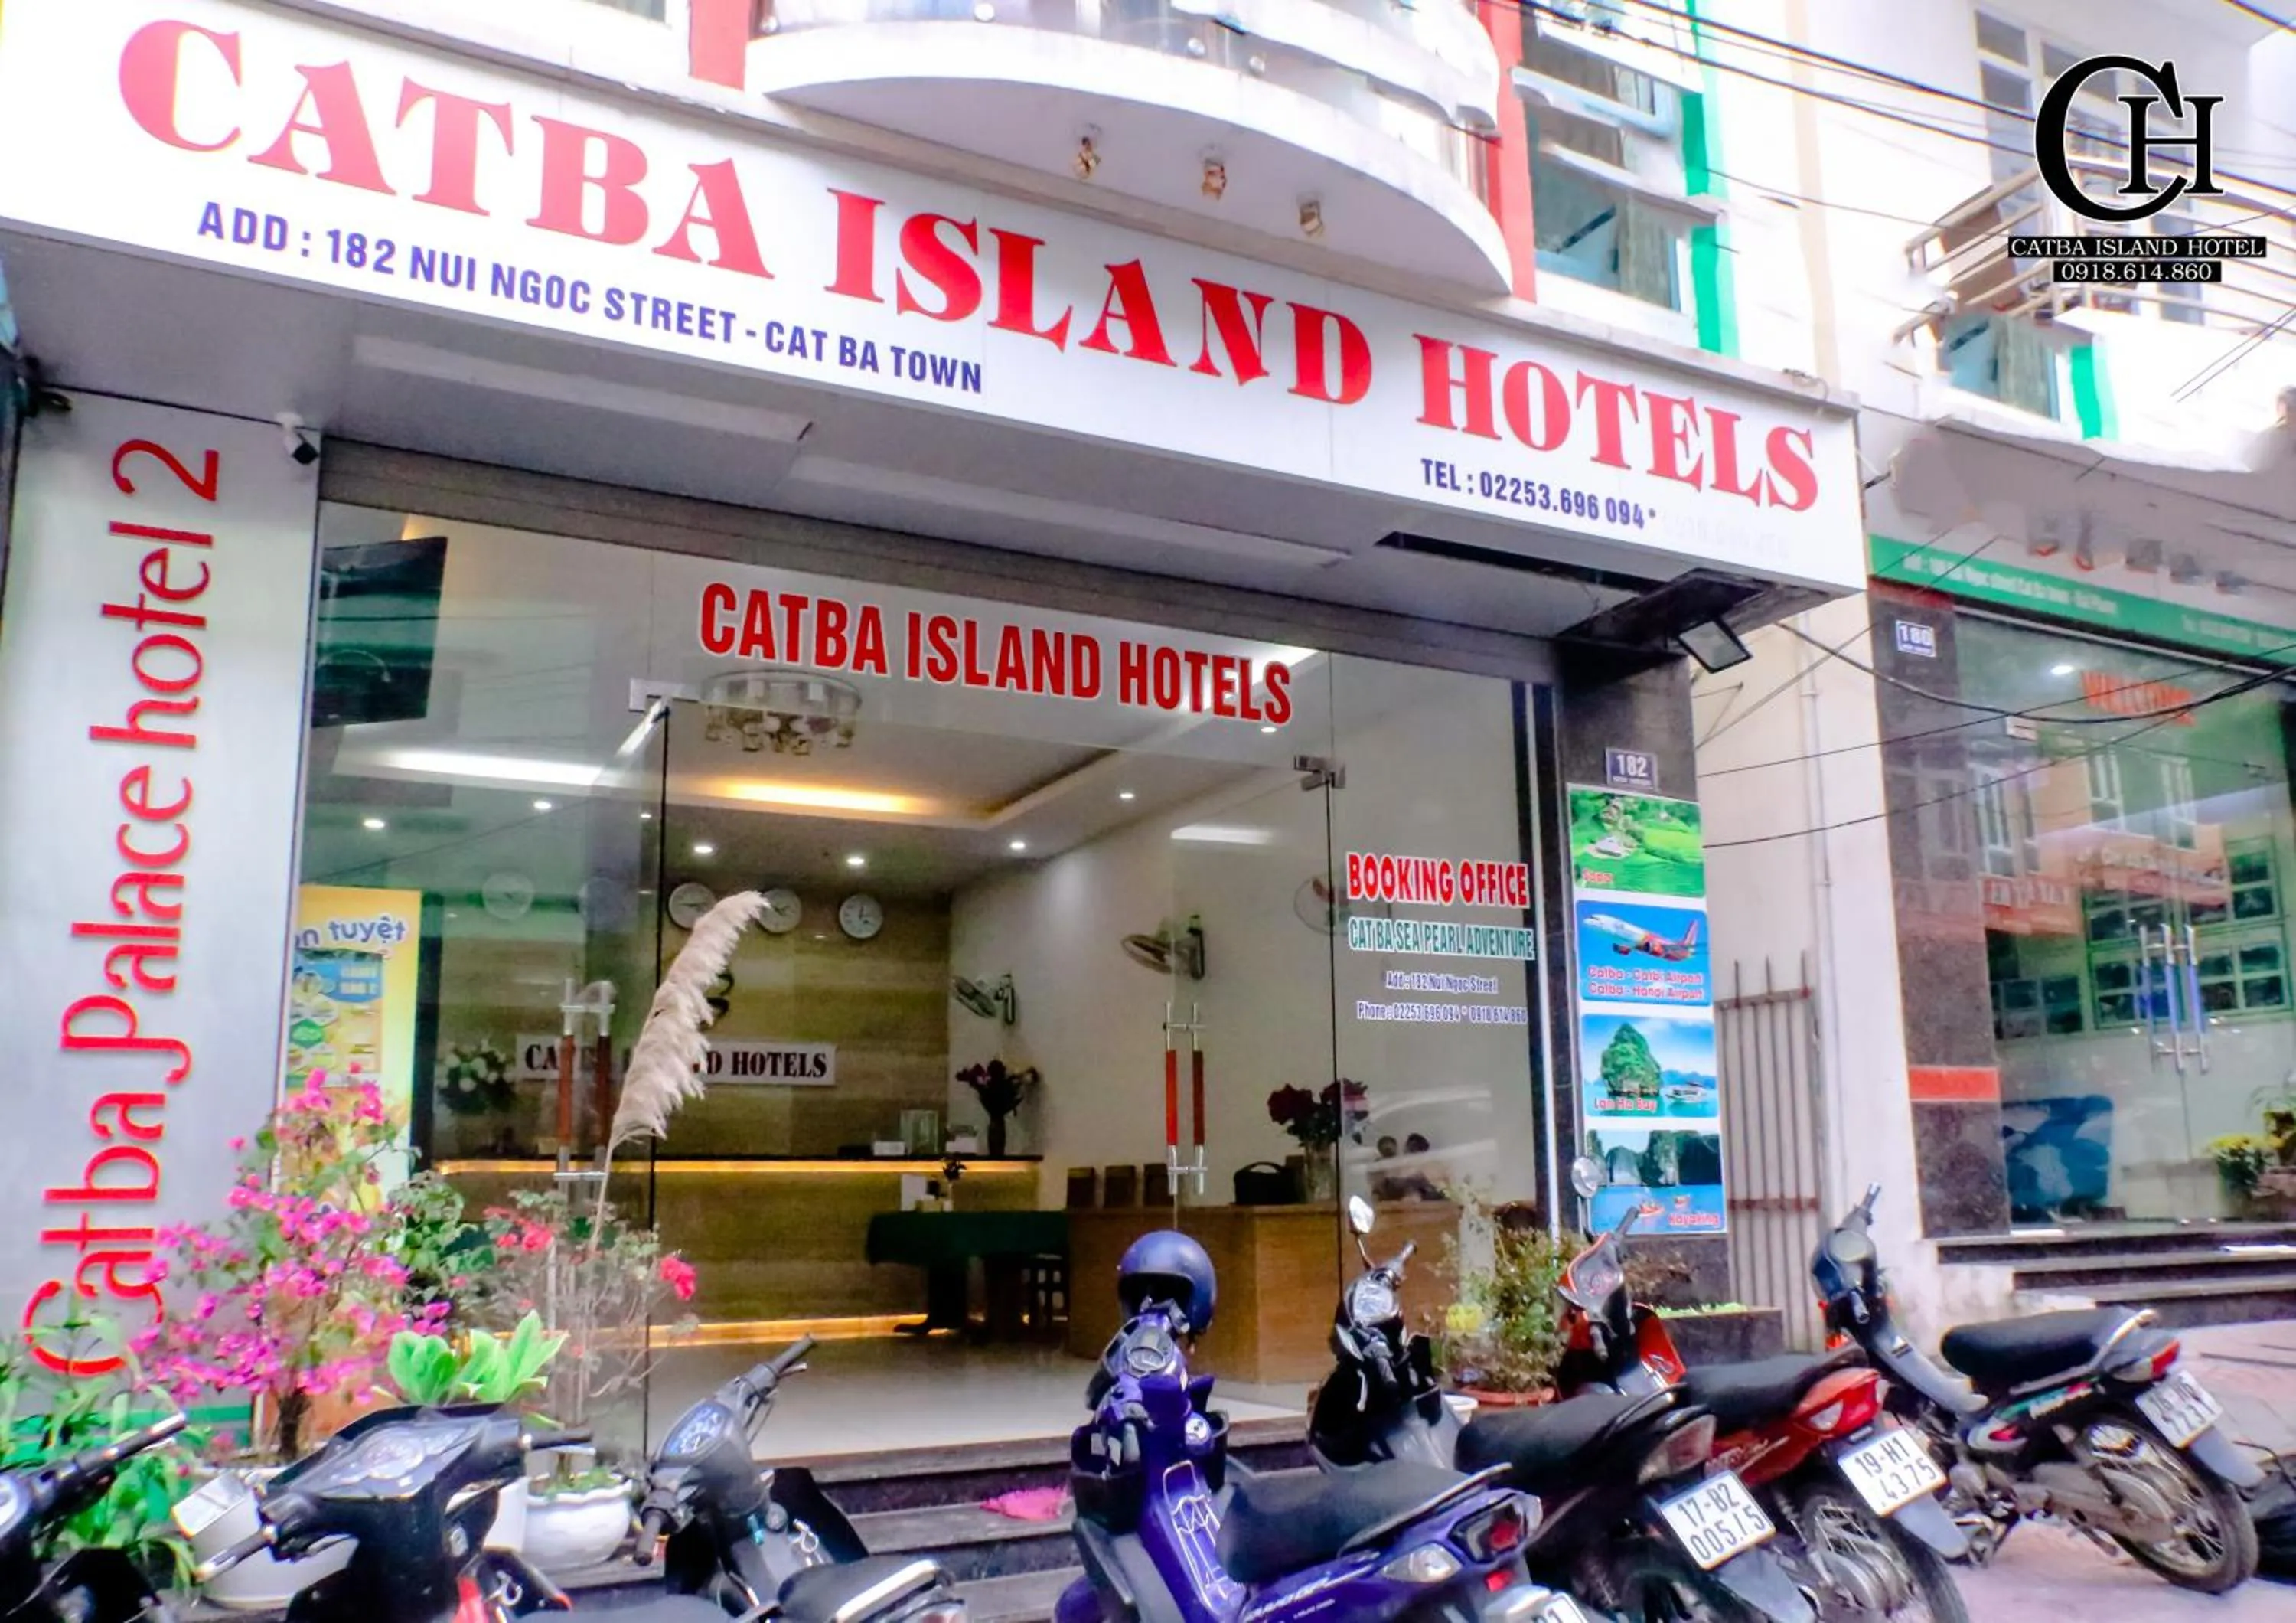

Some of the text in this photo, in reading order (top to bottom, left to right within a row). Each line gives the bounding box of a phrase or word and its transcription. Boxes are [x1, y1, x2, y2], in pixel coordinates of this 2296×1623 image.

[119, 19, 1819, 513] CATBA ISLAND HOTELS
[327, 228, 396, 274] 182
[409, 245, 476, 292] NUI
[490, 263, 591, 315] NGOC
[603, 287, 736, 344] STREET
[764, 320, 828, 363] CAT
[838, 335, 879, 374] BA
[889, 345, 983, 394] TOWN
[110, 438, 220, 503] 2
[88, 519, 214, 749] hotel
[700, 582, 1293, 725] CATBA ISLAND HOTELS
[1616, 753, 1649, 777] 182
[1347, 852, 1529, 909] BOOKING OFFICE
[328, 916, 406, 945] tuyệt
[1395, 920, 1421, 952] SEA
[1424, 922, 1463, 955] PEARL
[1466, 925, 1535, 960] ADVENTURE
[730, 1050, 827, 1078] HOTELS
